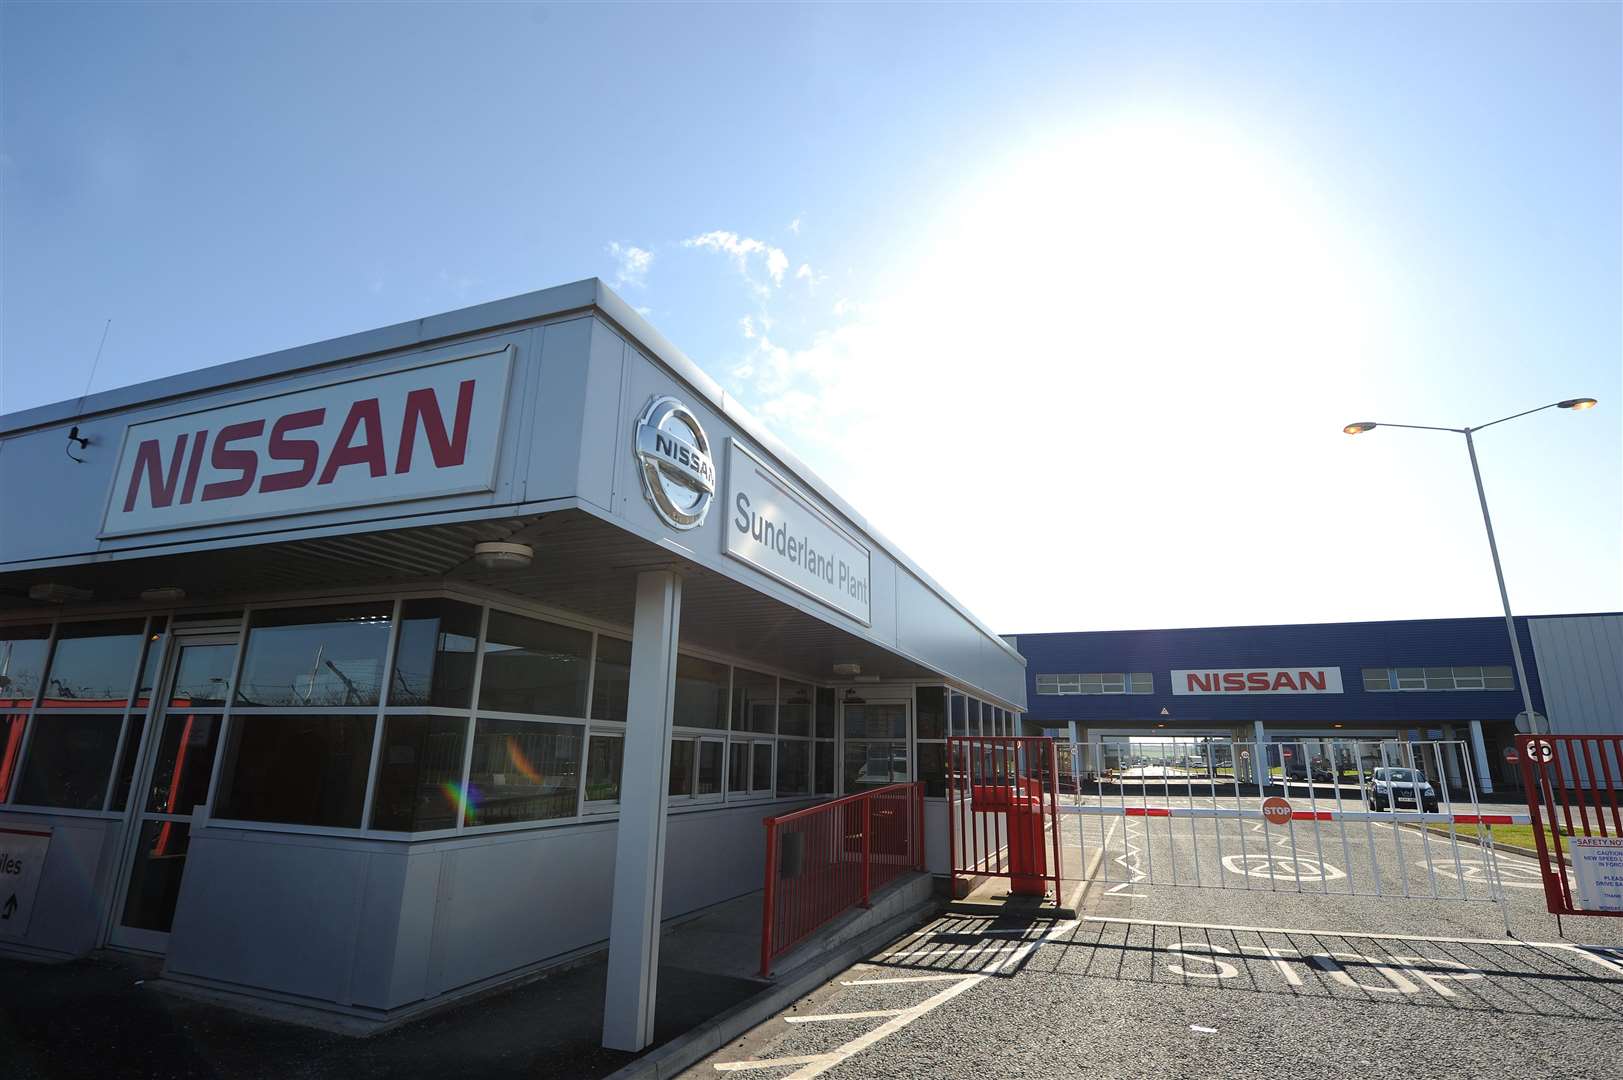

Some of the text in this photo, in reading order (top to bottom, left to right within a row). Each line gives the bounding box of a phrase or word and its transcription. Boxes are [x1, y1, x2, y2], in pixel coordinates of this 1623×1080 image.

[123, 379, 476, 513] NISSAN
[655, 434, 715, 486] NISSAN
[734, 491, 868, 605] Sunderland Plant
[1186, 670, 1327, 693] NISSAN
[1264, 806, 1292, 816] STOP
[1577, 838, 1607, 846] SAFETY
[1167, 942, 1484, 998] STOP
